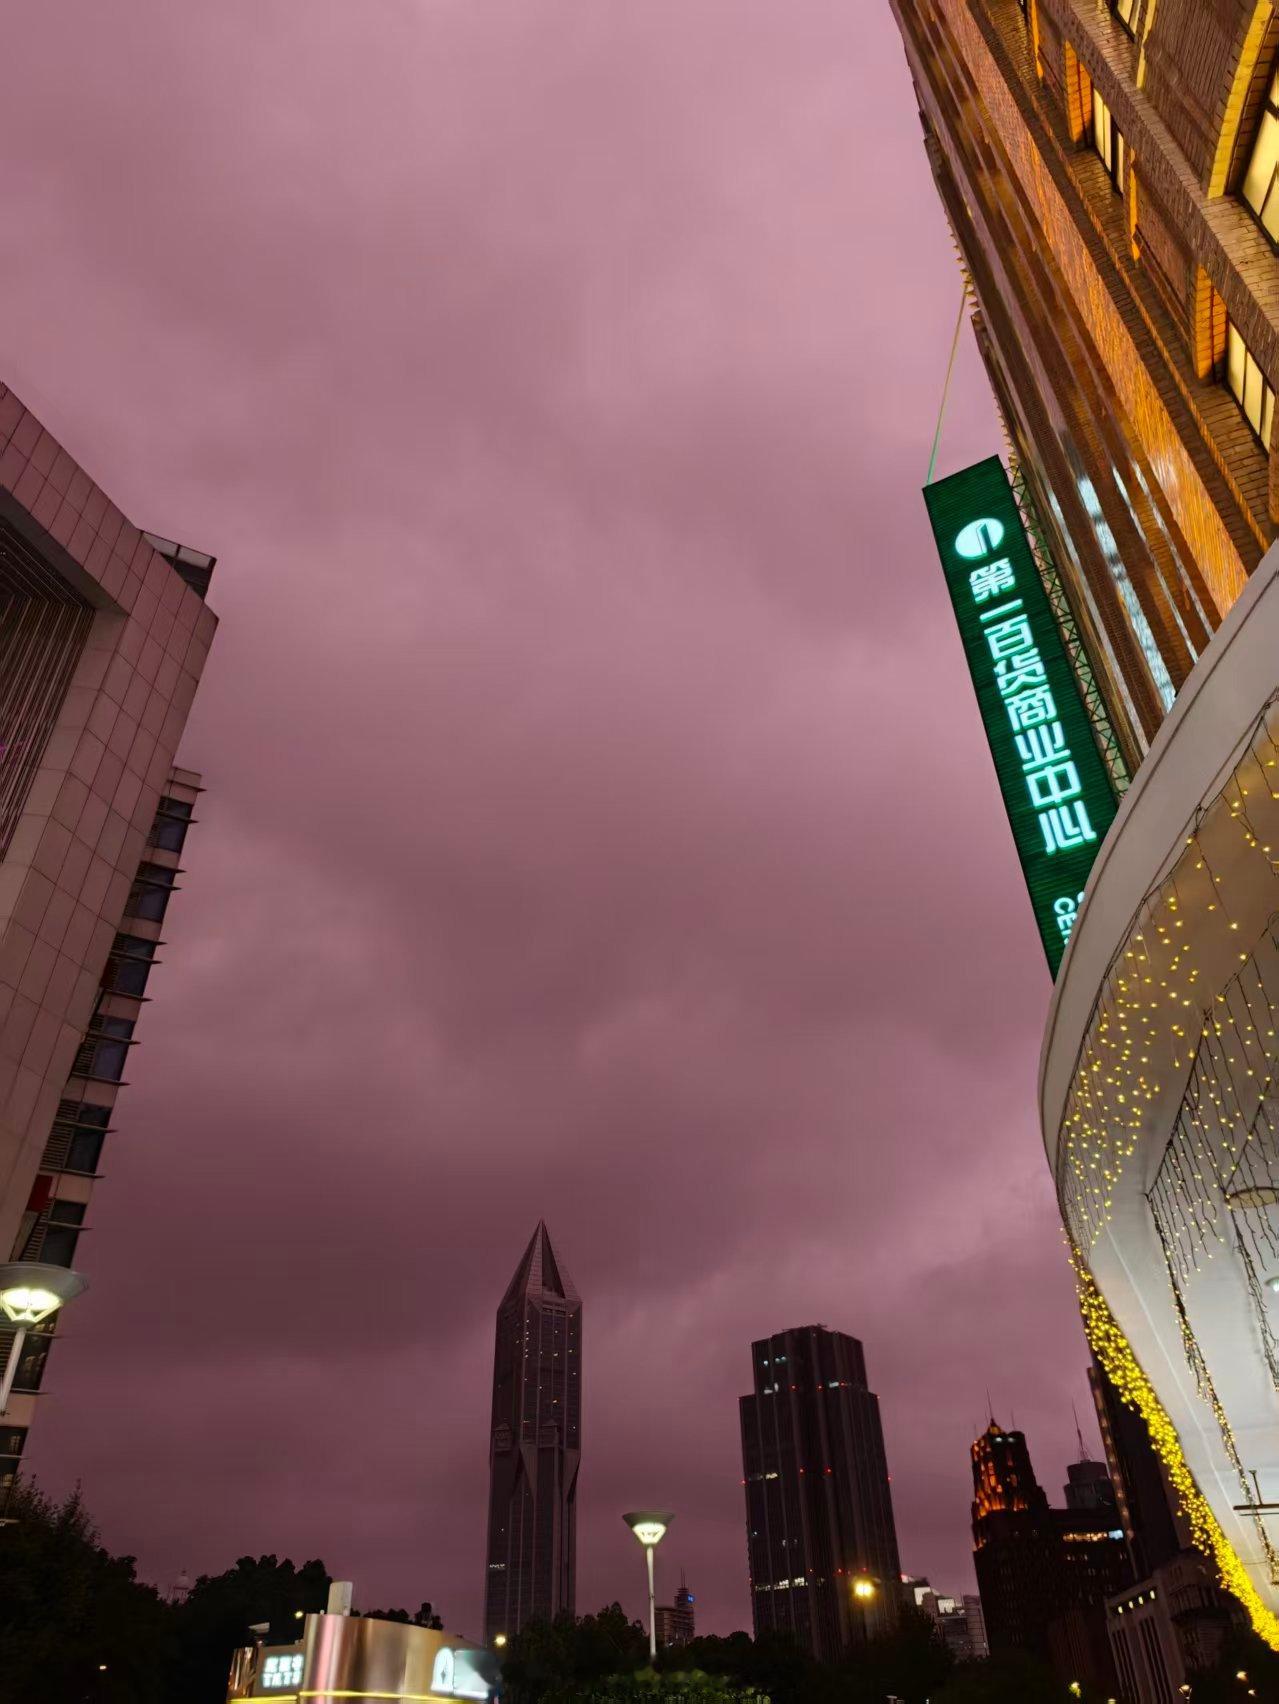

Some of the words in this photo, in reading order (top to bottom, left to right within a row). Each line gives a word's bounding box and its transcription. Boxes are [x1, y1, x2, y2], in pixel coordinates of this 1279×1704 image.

[969, 558, 1097, 855] 第一百货商业中心
